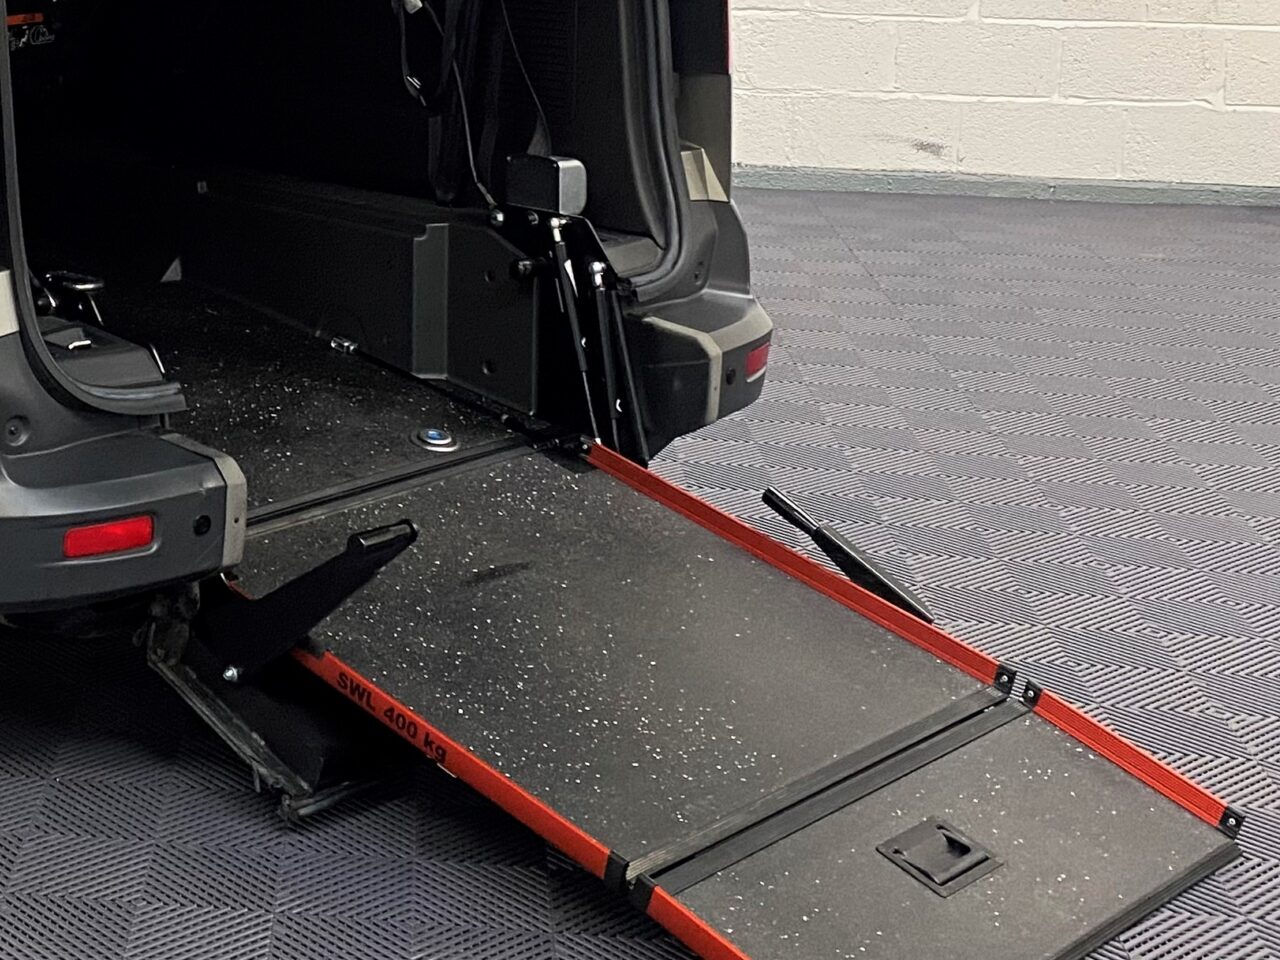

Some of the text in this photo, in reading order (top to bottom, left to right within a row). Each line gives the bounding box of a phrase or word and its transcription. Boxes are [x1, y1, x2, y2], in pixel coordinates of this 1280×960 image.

[336, 671, 448, 764] SWL 400 kg
